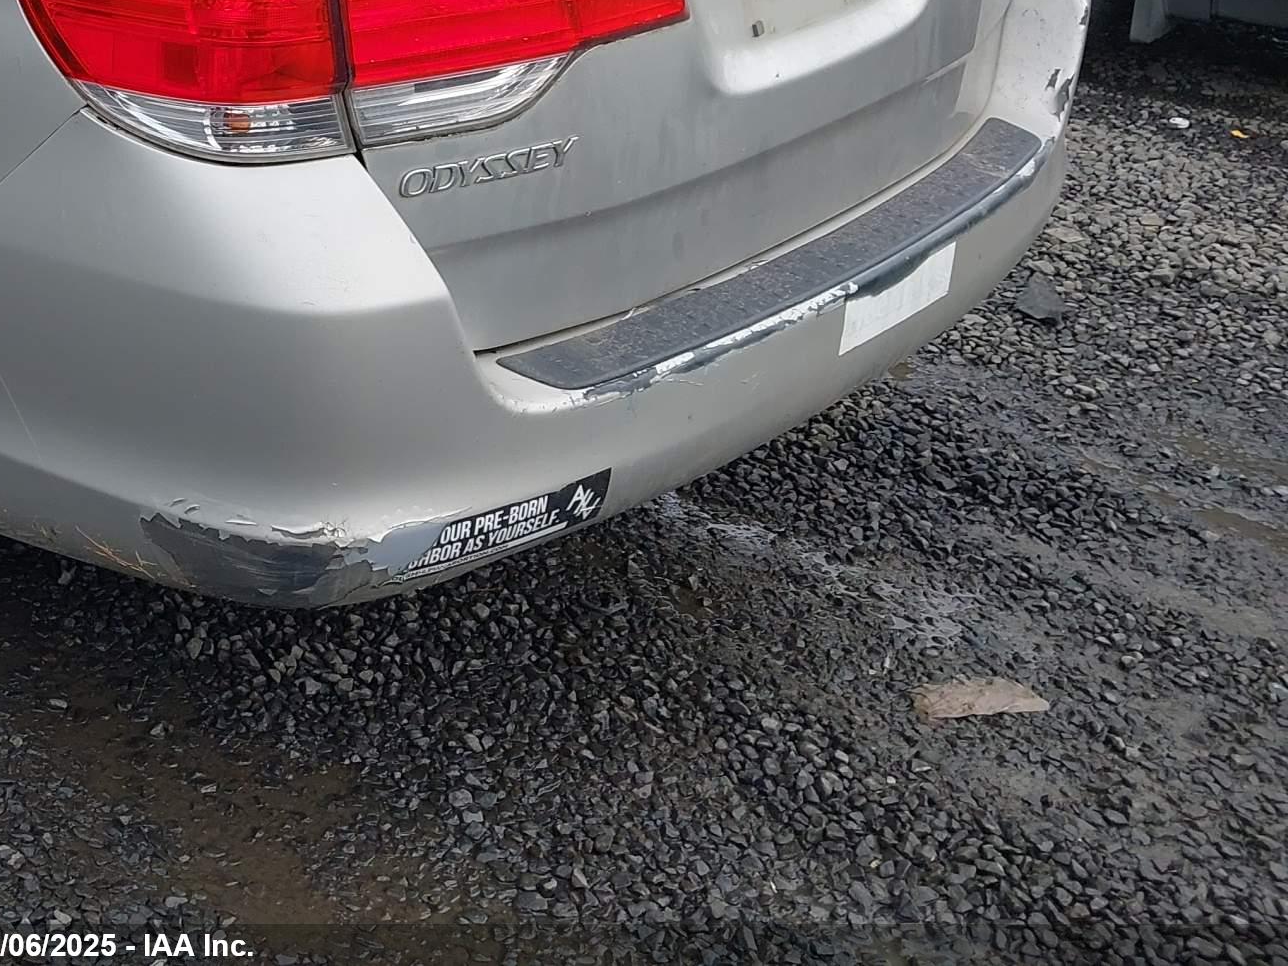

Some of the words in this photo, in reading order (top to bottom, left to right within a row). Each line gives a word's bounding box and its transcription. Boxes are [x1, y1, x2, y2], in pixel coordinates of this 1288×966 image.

[399, 135, 579, 198] ODYSSEY
[433, 519, 472, 546] OUR
[473, 495, 549, 536] PRE-BORN
[462, 534, 486, 555] AS
[487, 509, 560, 547] YOURSELF.
